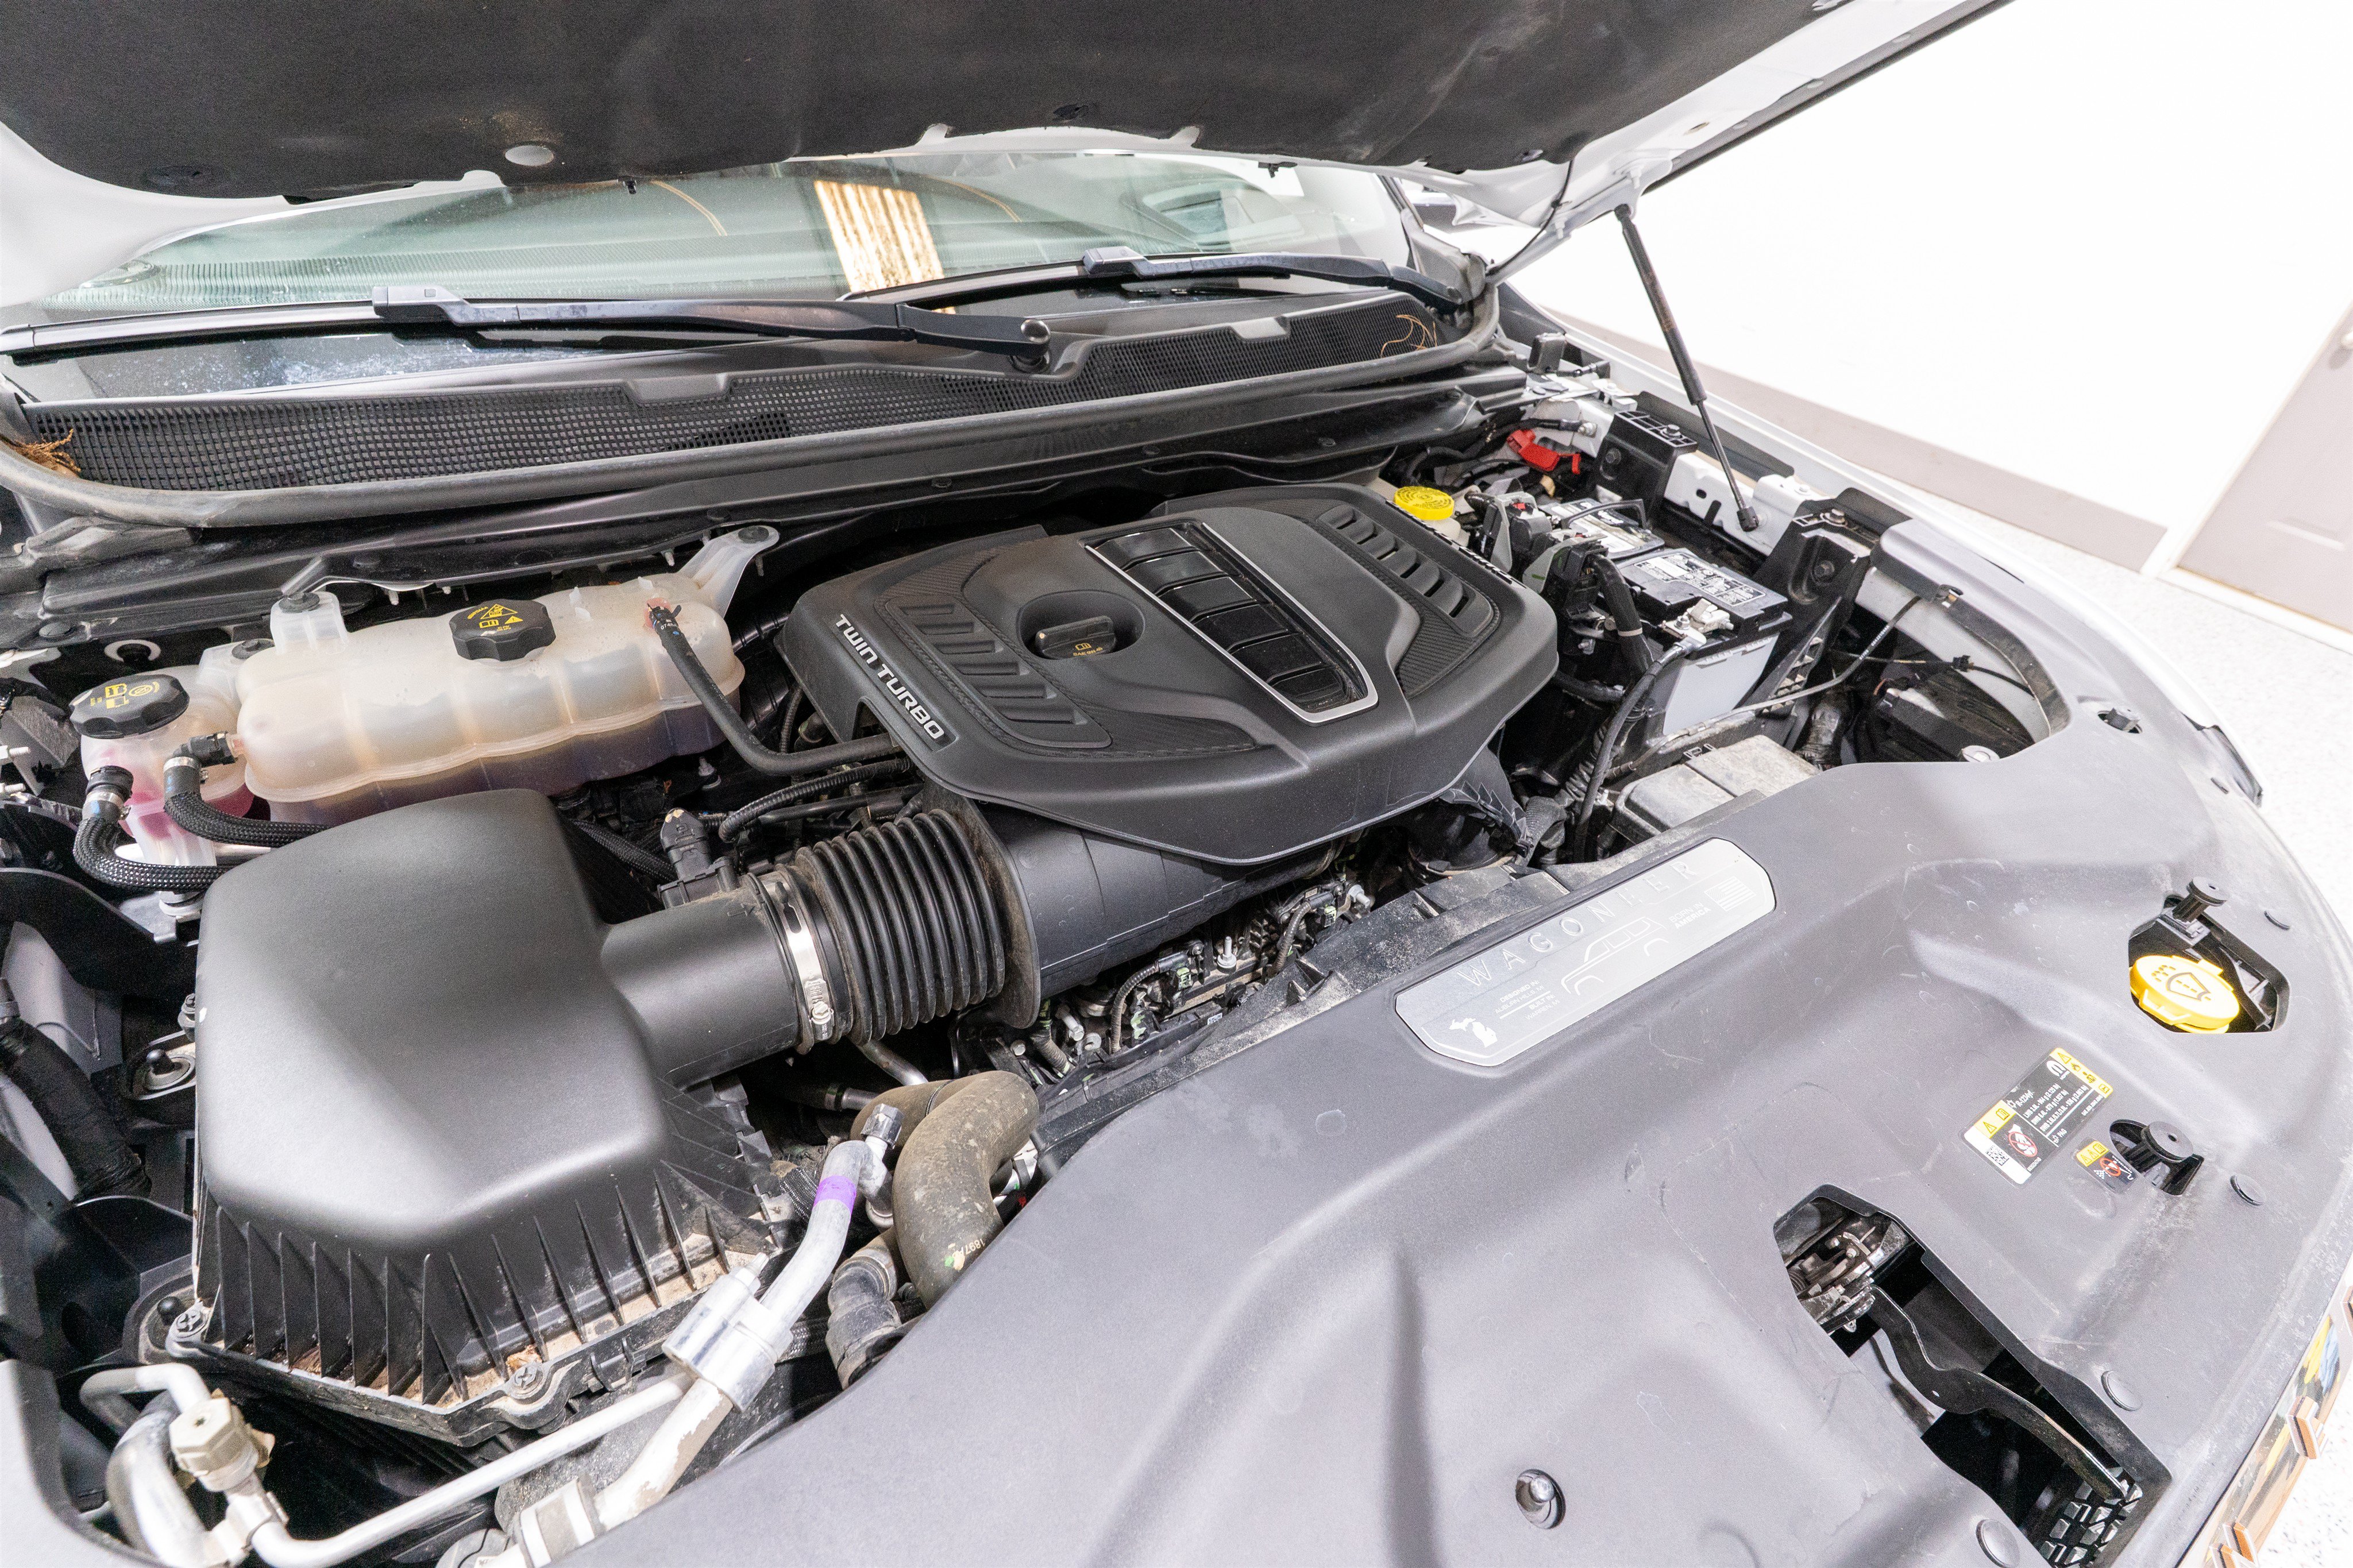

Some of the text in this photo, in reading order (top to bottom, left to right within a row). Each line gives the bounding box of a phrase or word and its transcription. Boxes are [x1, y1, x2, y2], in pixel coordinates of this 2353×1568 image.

[836, 613, 944, 739] TWIN TURBO
[1668, 902, 1704, 923] BORN IN
[1674, 907, 1711, 929] AMERICA
[1457, 860, 1699, 987] WAGONEER
[1500, 984, 1531, 1002] DESIGNED
[1495, 998, 1520, 1014] AUBURN
[1528, 997, 1546, 1010] BUILT
[2015, 1090, 2034, 1107] R-1234yf
[2057, 1128, 2067, 1138] PAG
